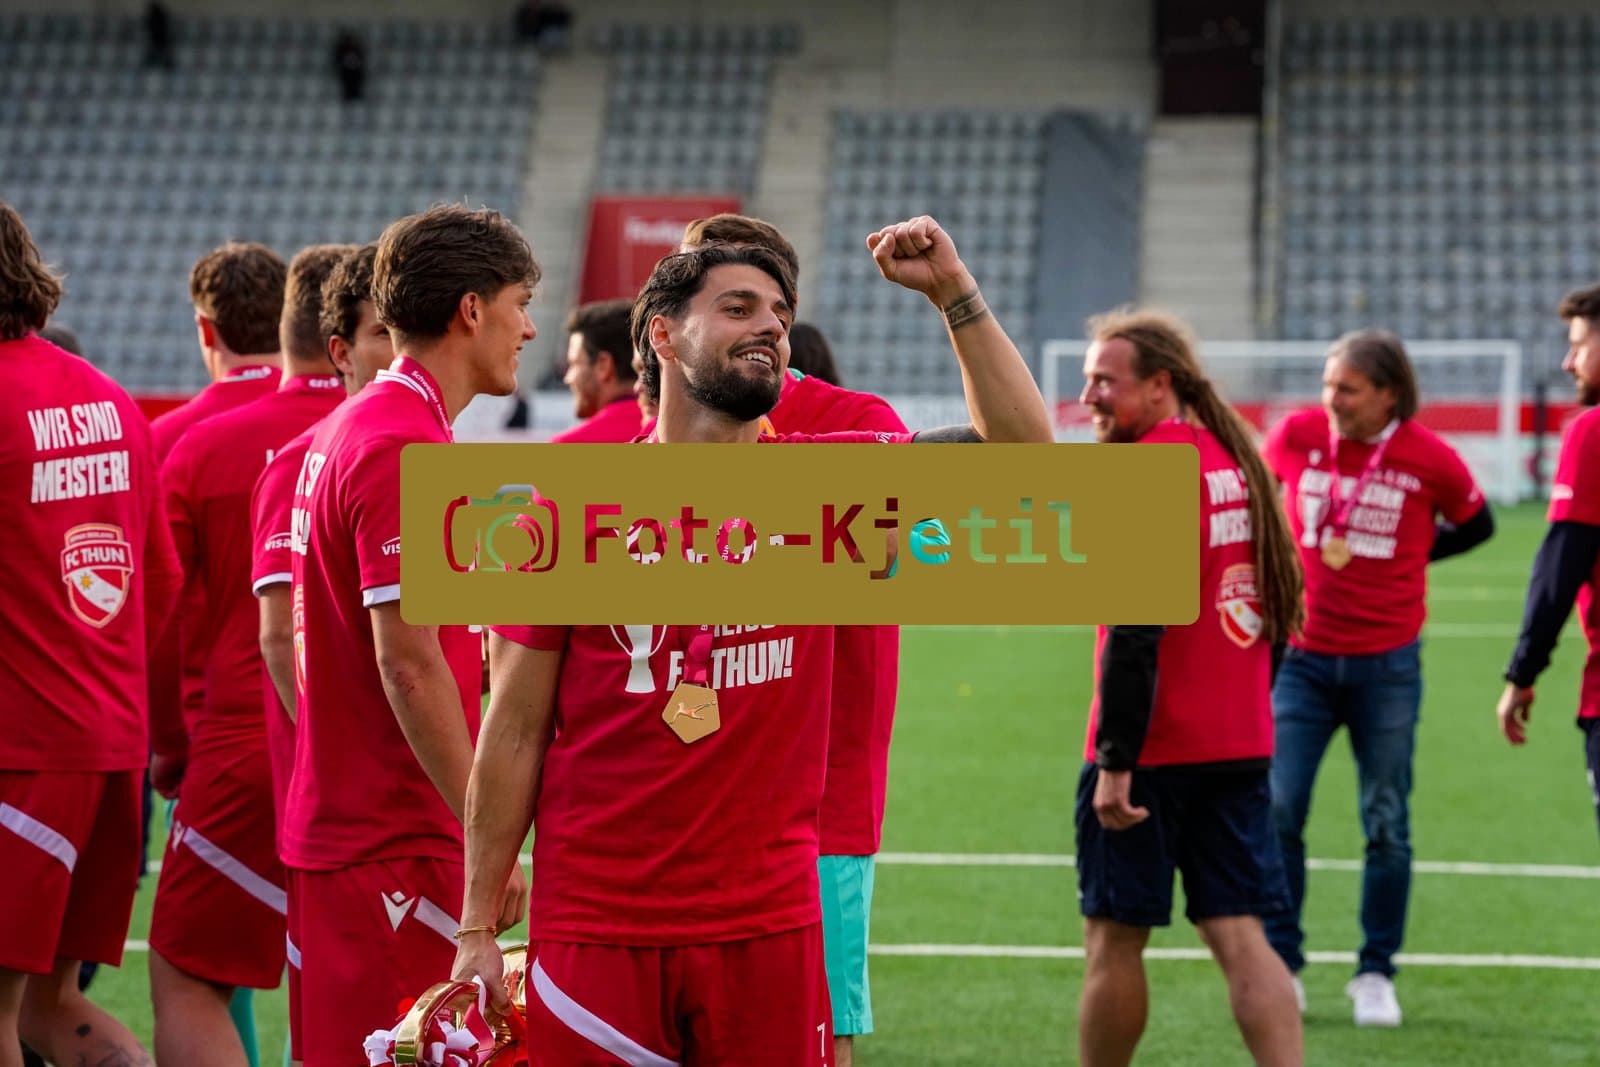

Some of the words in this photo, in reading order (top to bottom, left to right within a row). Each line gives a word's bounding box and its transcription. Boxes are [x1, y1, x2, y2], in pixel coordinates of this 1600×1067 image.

[27, 407, 75, 452] WIR
[71, 400, 123, 446] SIND
[31, 450, 130, 504] MEISTER!
[65, 549, 80, 570] FC
[80, 546, 126, 564] THUN
[666, 650, 685, 692] F
[710, 635, 795, 690] THUN!
